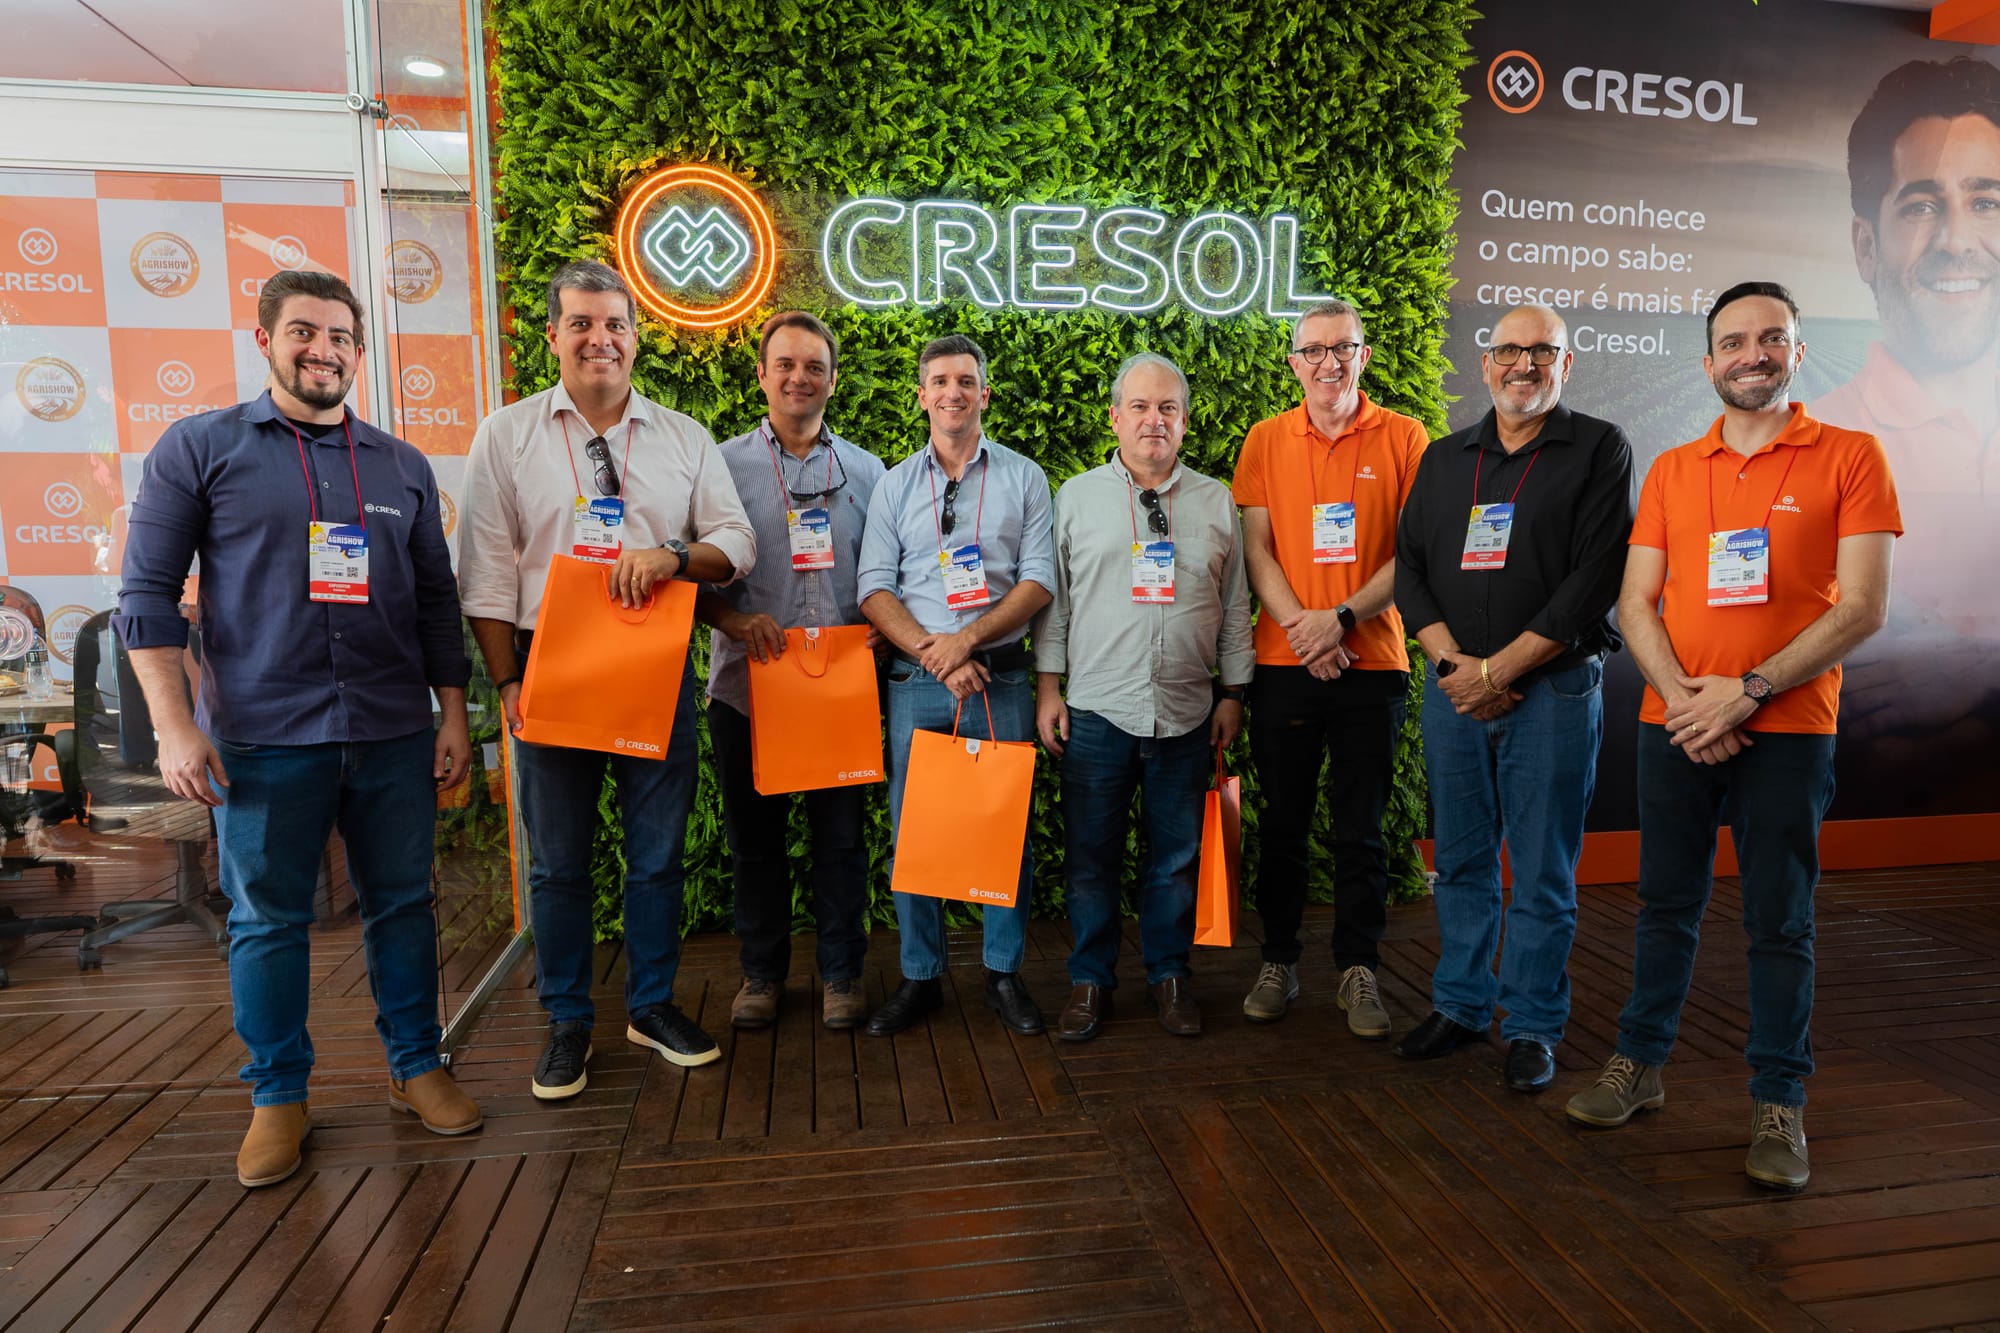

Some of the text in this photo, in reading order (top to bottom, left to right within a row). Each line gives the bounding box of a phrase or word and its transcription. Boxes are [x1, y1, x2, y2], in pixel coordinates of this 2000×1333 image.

[1562, 66, 1758, 126] CRESOL
[1481, 189, 1706, 231] Quem conhece
[823, 198, 1334, 317] CRESOL
[1479, 240, 1693, 273] o campo sabe:
[142, 259, 189, 270] AGRISHOW
[1477, 283, 1584, 309] crescer
[1591, 283, 1608, 311] é
[1617, 287, 1682, 314] mais
[1574, 325, 1671, 356] Cresol.
[27, 384, 75, 394] AGRISHOW
[375, 505, 402, 518] CRESOL
[327, 535, 364, 546] AGRISHOW
[1727, 539, 1764, 550] AGRISHOW
[626, 741, 661, 753] CRESOL
[848, 769, 878, 779] CRESOL
[979, 890, 1010, 901] CRESOL
